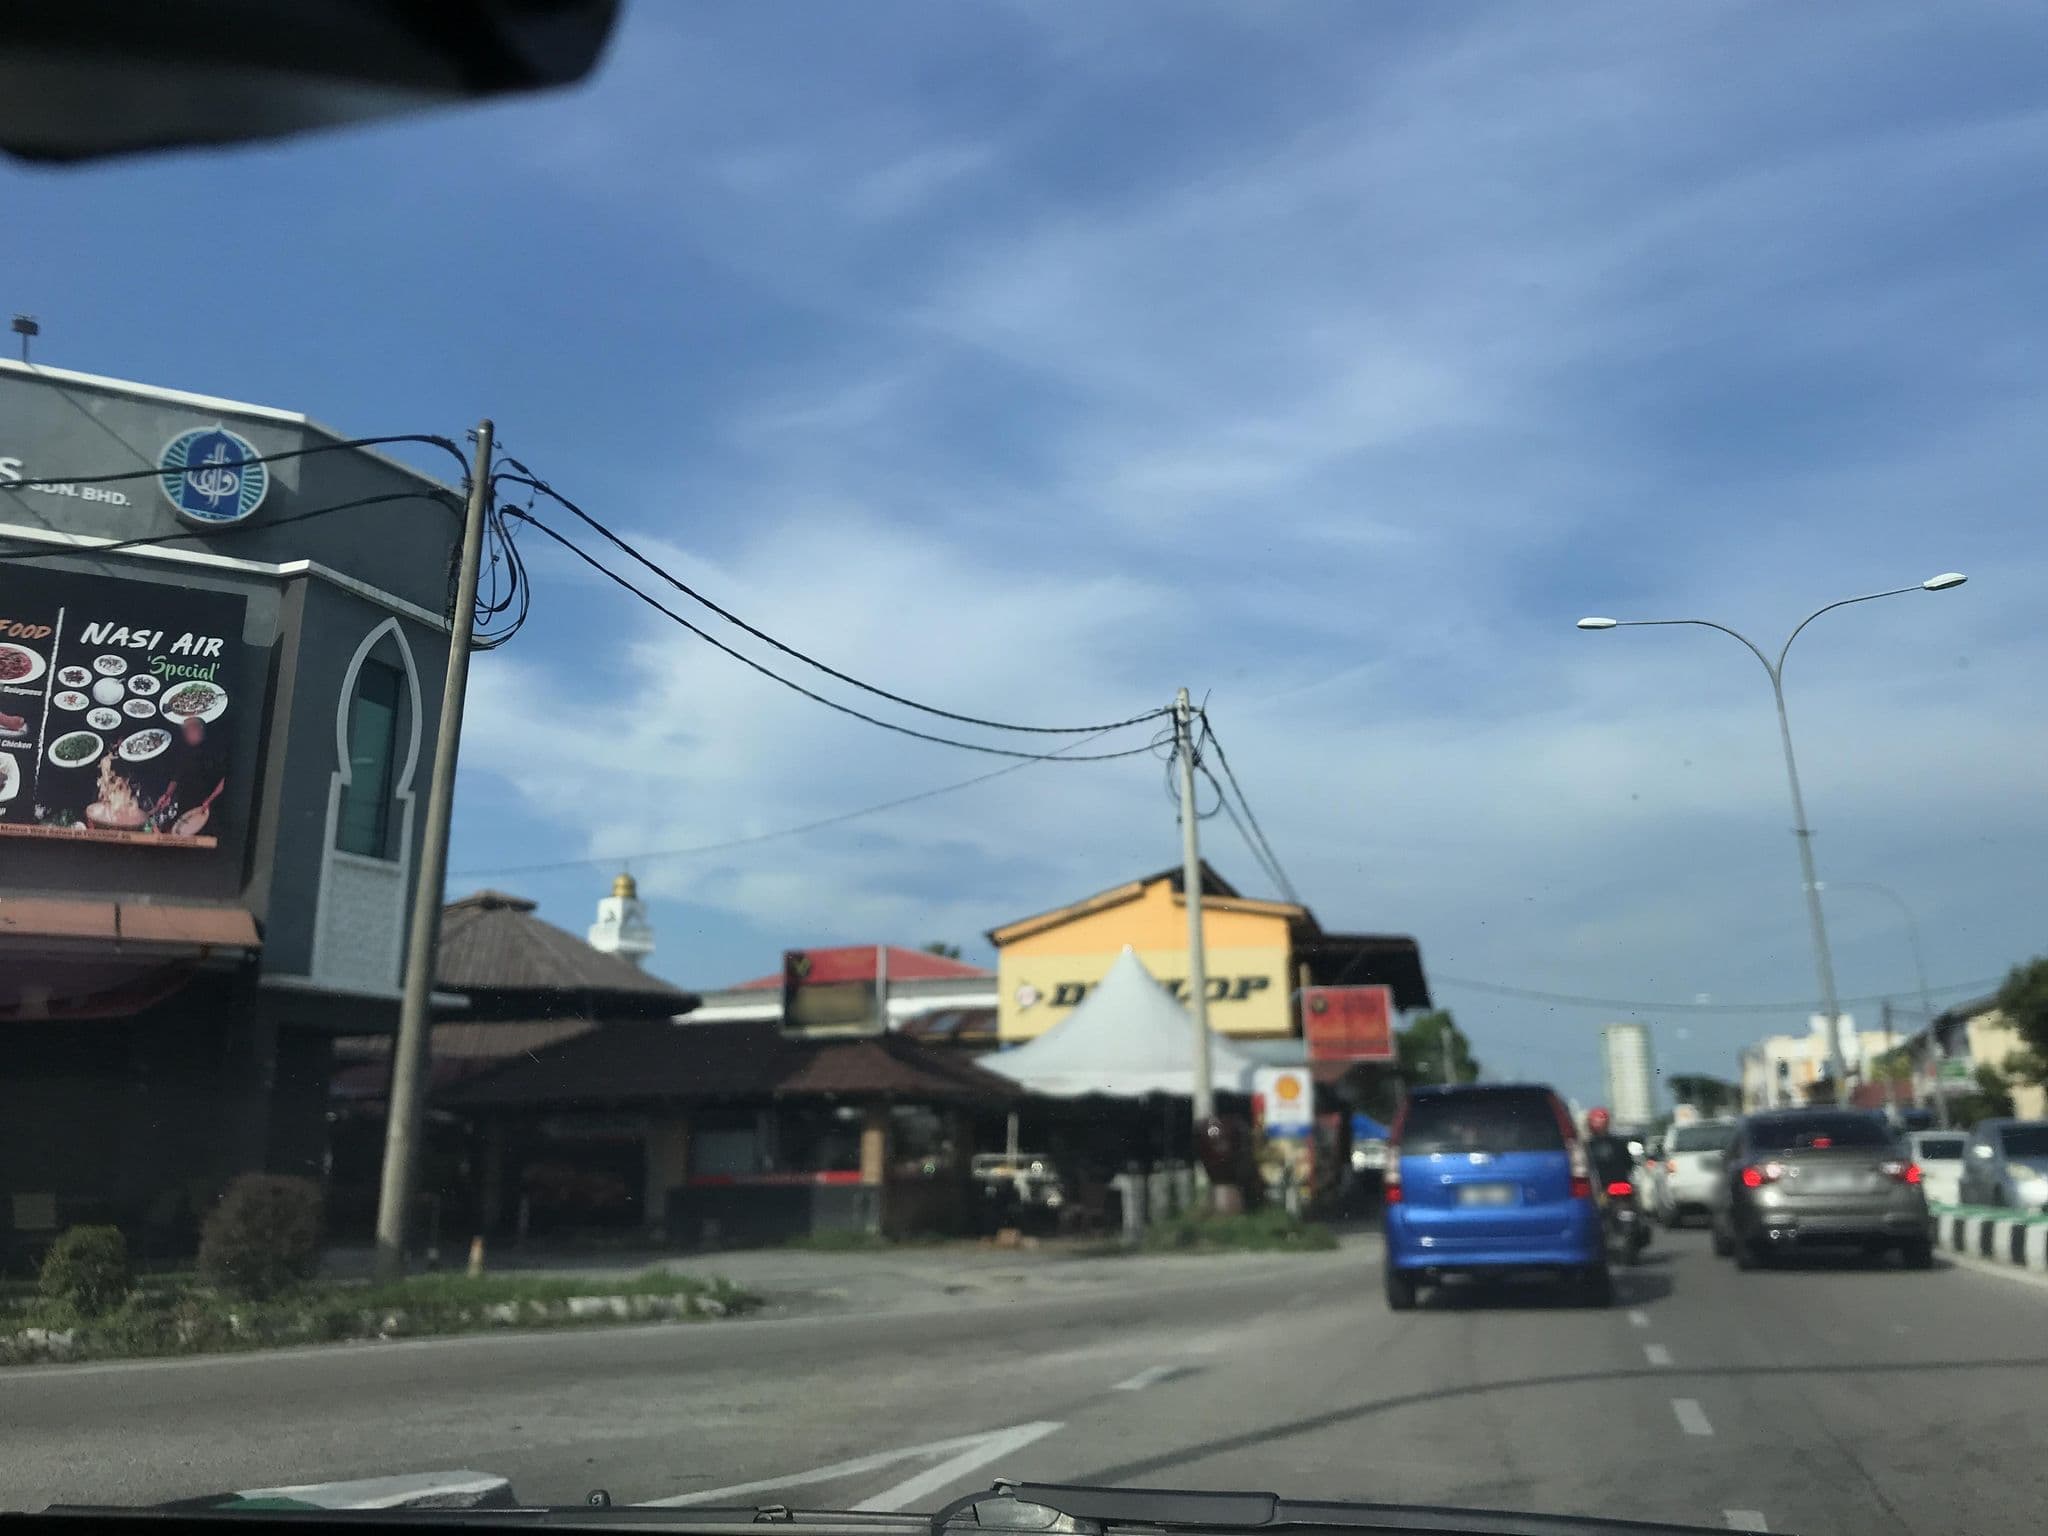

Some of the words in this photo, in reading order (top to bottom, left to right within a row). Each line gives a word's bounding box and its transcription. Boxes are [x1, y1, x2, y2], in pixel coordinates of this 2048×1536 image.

[81, 487, 132, 506] BHD.
[80, 621, 164, 650] NASI
[169, 632, 224, 657] AIR
